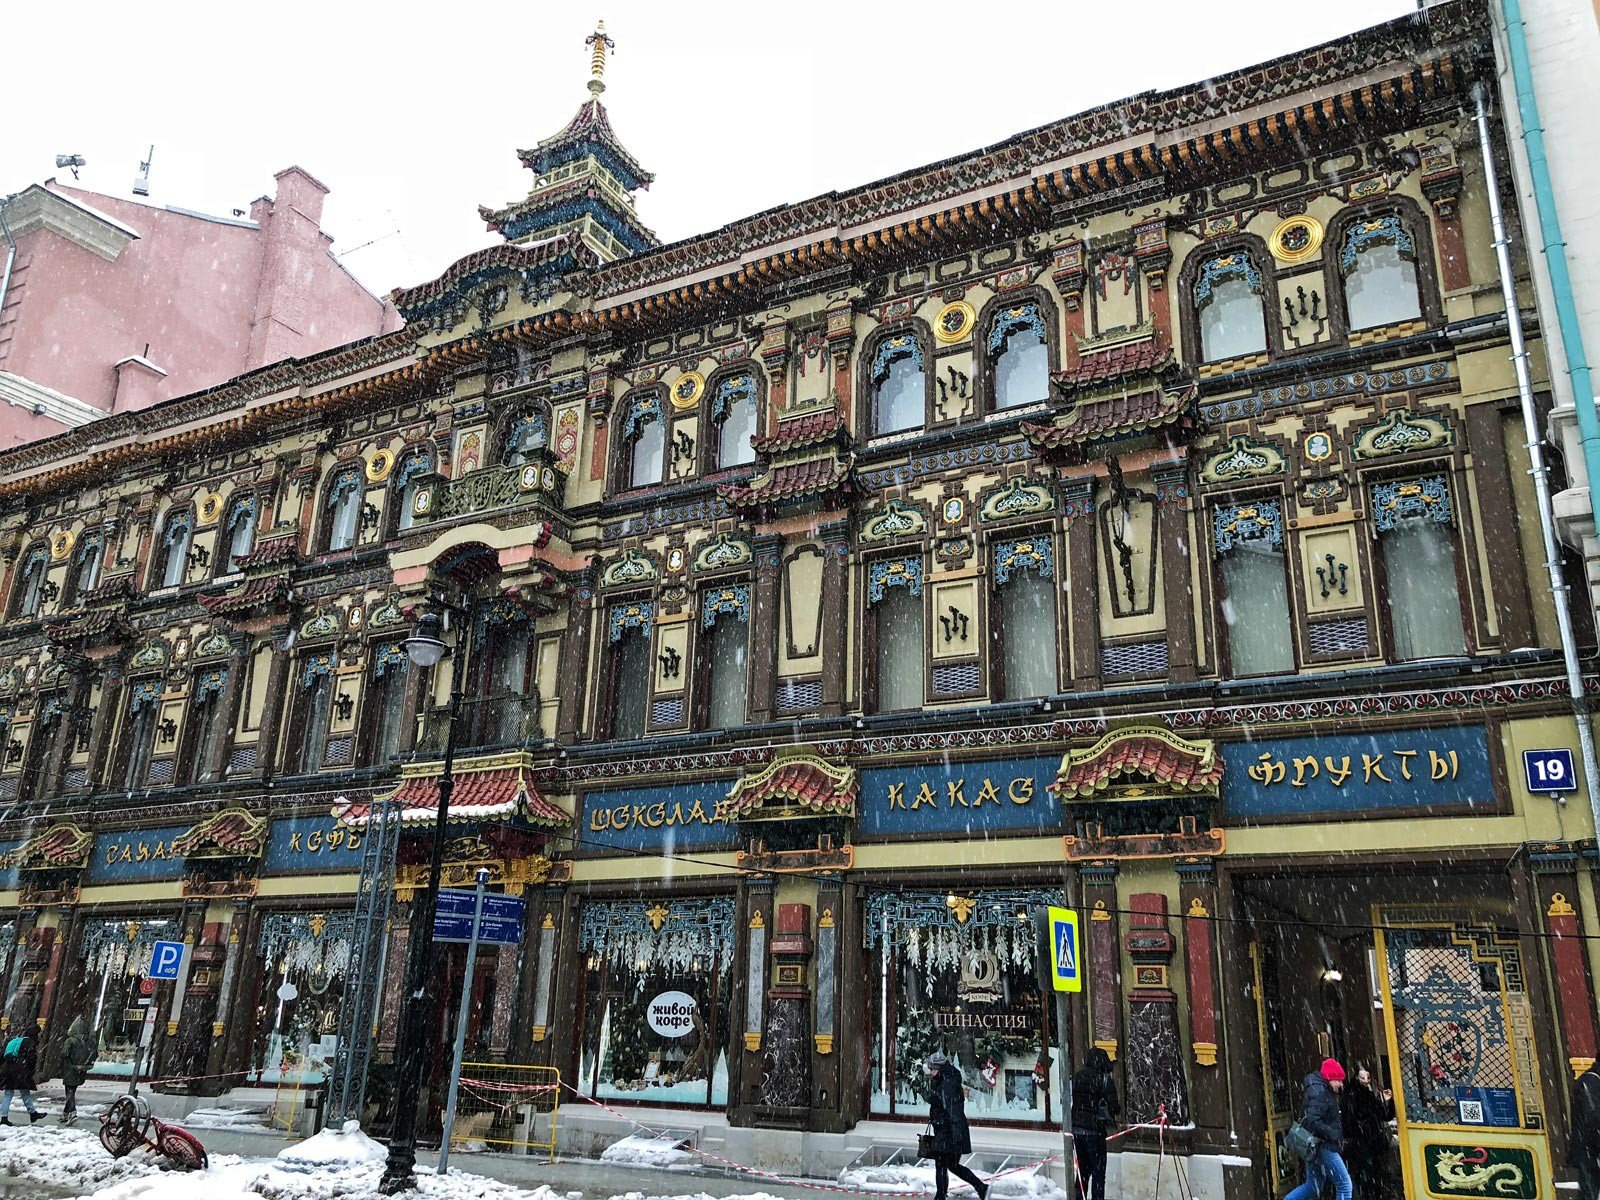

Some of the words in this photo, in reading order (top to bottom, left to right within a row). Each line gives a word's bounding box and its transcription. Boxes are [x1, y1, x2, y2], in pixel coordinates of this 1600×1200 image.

[1248, 750, 1459, 787] ФРУКТЫ
[1534, 759, 1565, 782] 19
[887, 777, 1035, 811] КАКАО
[653, 1002, 694, 1016] живой
[655, 1015, 690, 1029] кофе
[936, 1013, 1027, 1028] ДИНАСТИЯ
